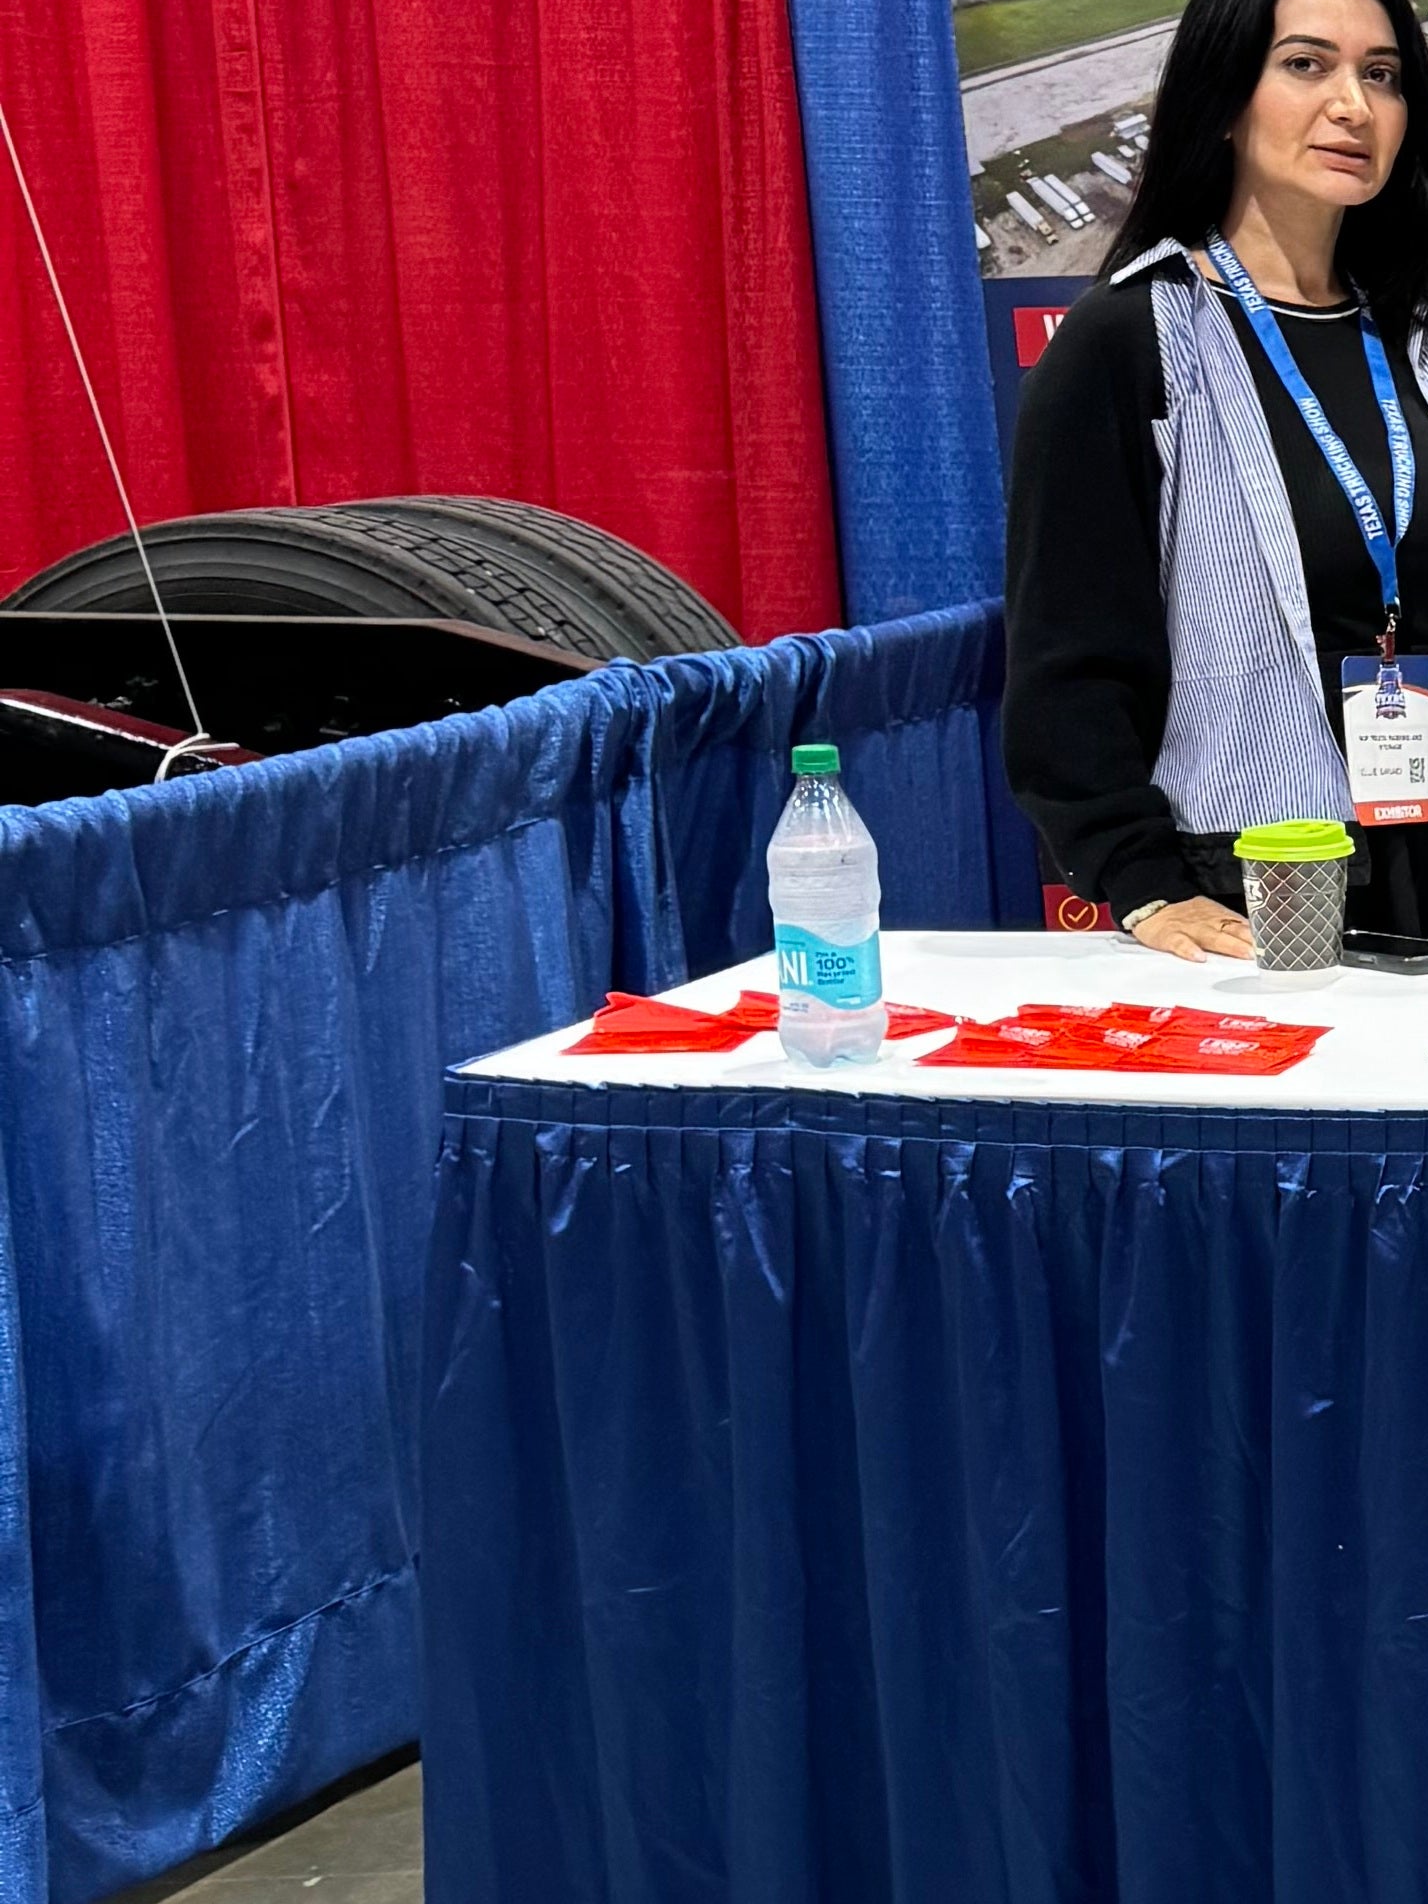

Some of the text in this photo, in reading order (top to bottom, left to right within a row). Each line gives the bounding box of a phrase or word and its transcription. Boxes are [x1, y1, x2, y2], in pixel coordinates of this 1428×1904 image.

[1233, 276, 1268, 314] TEXAS
[1299, 397, 1384, 541] TEXAS TRUCKING SHOW
[1391, 434, 1412, 498] TRUCKING
